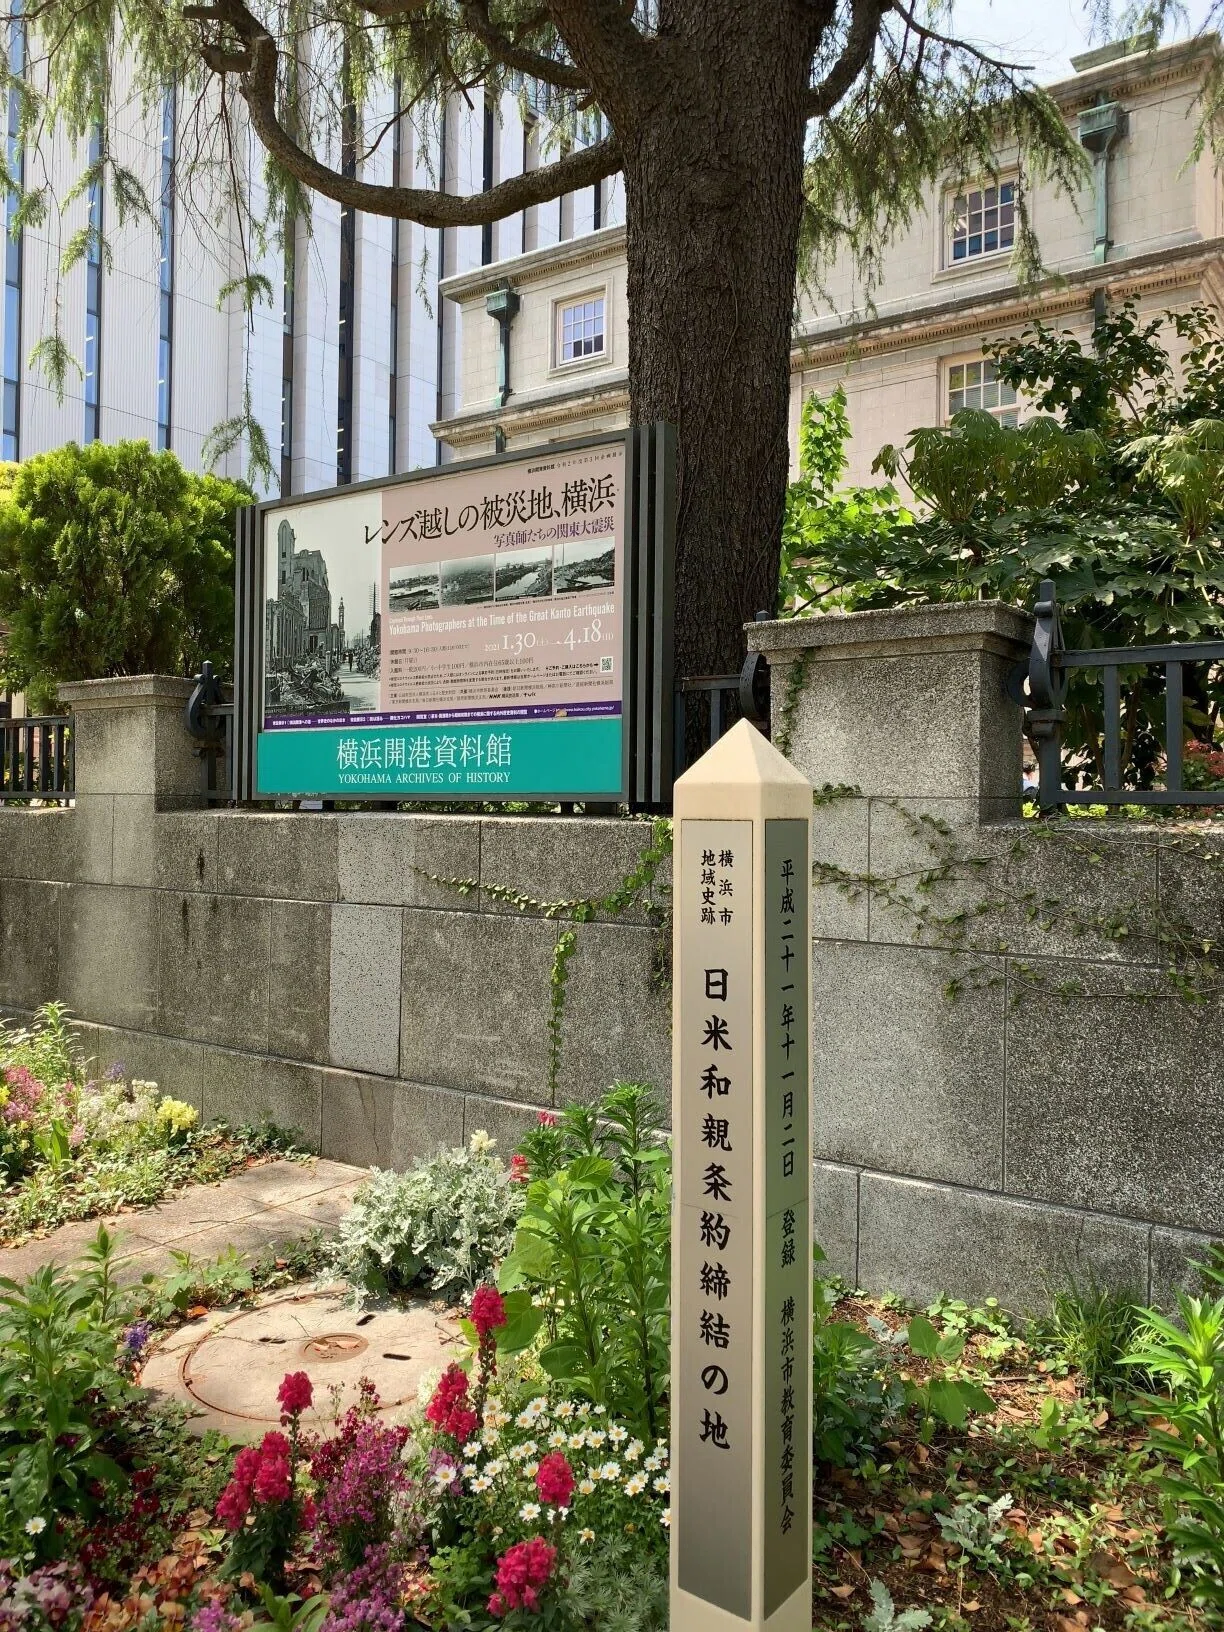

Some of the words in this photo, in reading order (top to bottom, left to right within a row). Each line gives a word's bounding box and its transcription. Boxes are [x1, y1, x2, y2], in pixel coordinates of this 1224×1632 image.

[365, 474, 616, 544] レンズ越しの被災地、横浜
[494, 516, 615, 548] 写真師たちの関東大震災
[389, 624, 420, 636] Yokohama
[421, 619, 467, 633] Photographers
[468, 618, 475, 628] at
[477, 616, 488, 627] the
[490, 614, 505, 626] Time
[507, 613, 514, 624] of
[516, 612, 528, 623] the
[529, 608, 548, 622] Great
[551, 607, 571, 620] Kanto
[573, 601, 615, 618] Earthquake
[337, 733, 512, 769] 横浜開港資料館
[338, 773, 392, 784] YOKOHAMA
[395, 773, 444, 783] ARCHIVES
[449, 772, 462, 783] OF
[466, 772, 511, 783] HISTORY
[701, 849, 716, 925] 地域史跡
[718, 850, 734, 926] 横浜市
[780, 859, 795, 1177] 平成二十一年十一月二日
[700, 968, 733, 1450] 日米和親条約締結の地
[781, 1209, 795, 1268] 登録
[780, 1296, 795, 1535] 横浜市教育委員会
